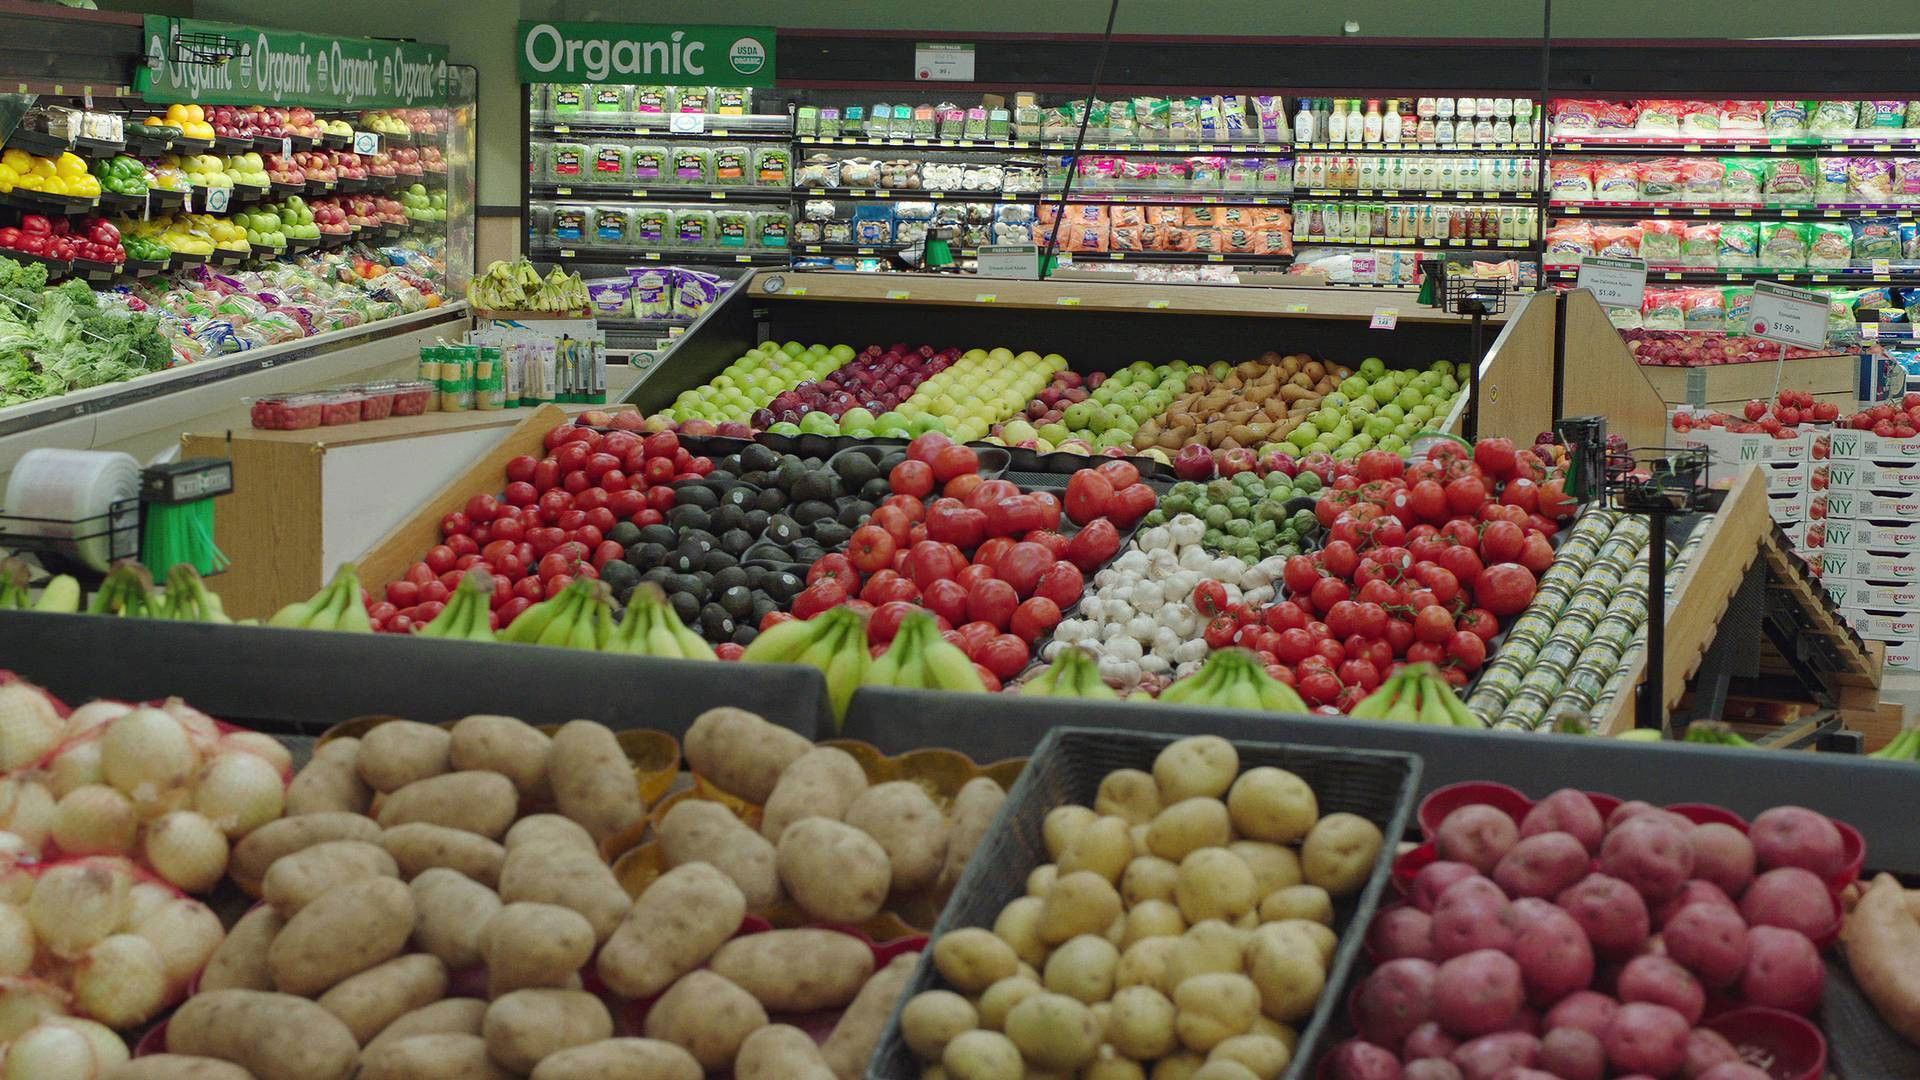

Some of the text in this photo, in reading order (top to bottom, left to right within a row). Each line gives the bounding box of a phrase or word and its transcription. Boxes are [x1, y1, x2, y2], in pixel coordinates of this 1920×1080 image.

[525, 24, 705, 81] Organic
[736, 46, 757, 54] USDA
[169, 24, 232, 99] Organic
[256, 33, 311, 102] Organic
[734, 57, 761, 65] ORGANIC
[331, 41, 377, 103] Organic
[394, 47, 434, 105] Organic
[1773, 322, 1794, 333] $1.99
[1740, 446, 1758, 460] NY
[1832, 442, 1856, 455] NY
[1830, 470, 1854, 485] NY
[1828, 499, 1851, 514] NY
[1826, 529, 1850, 545] NY
[1822, 560, 1847, 574] NY
